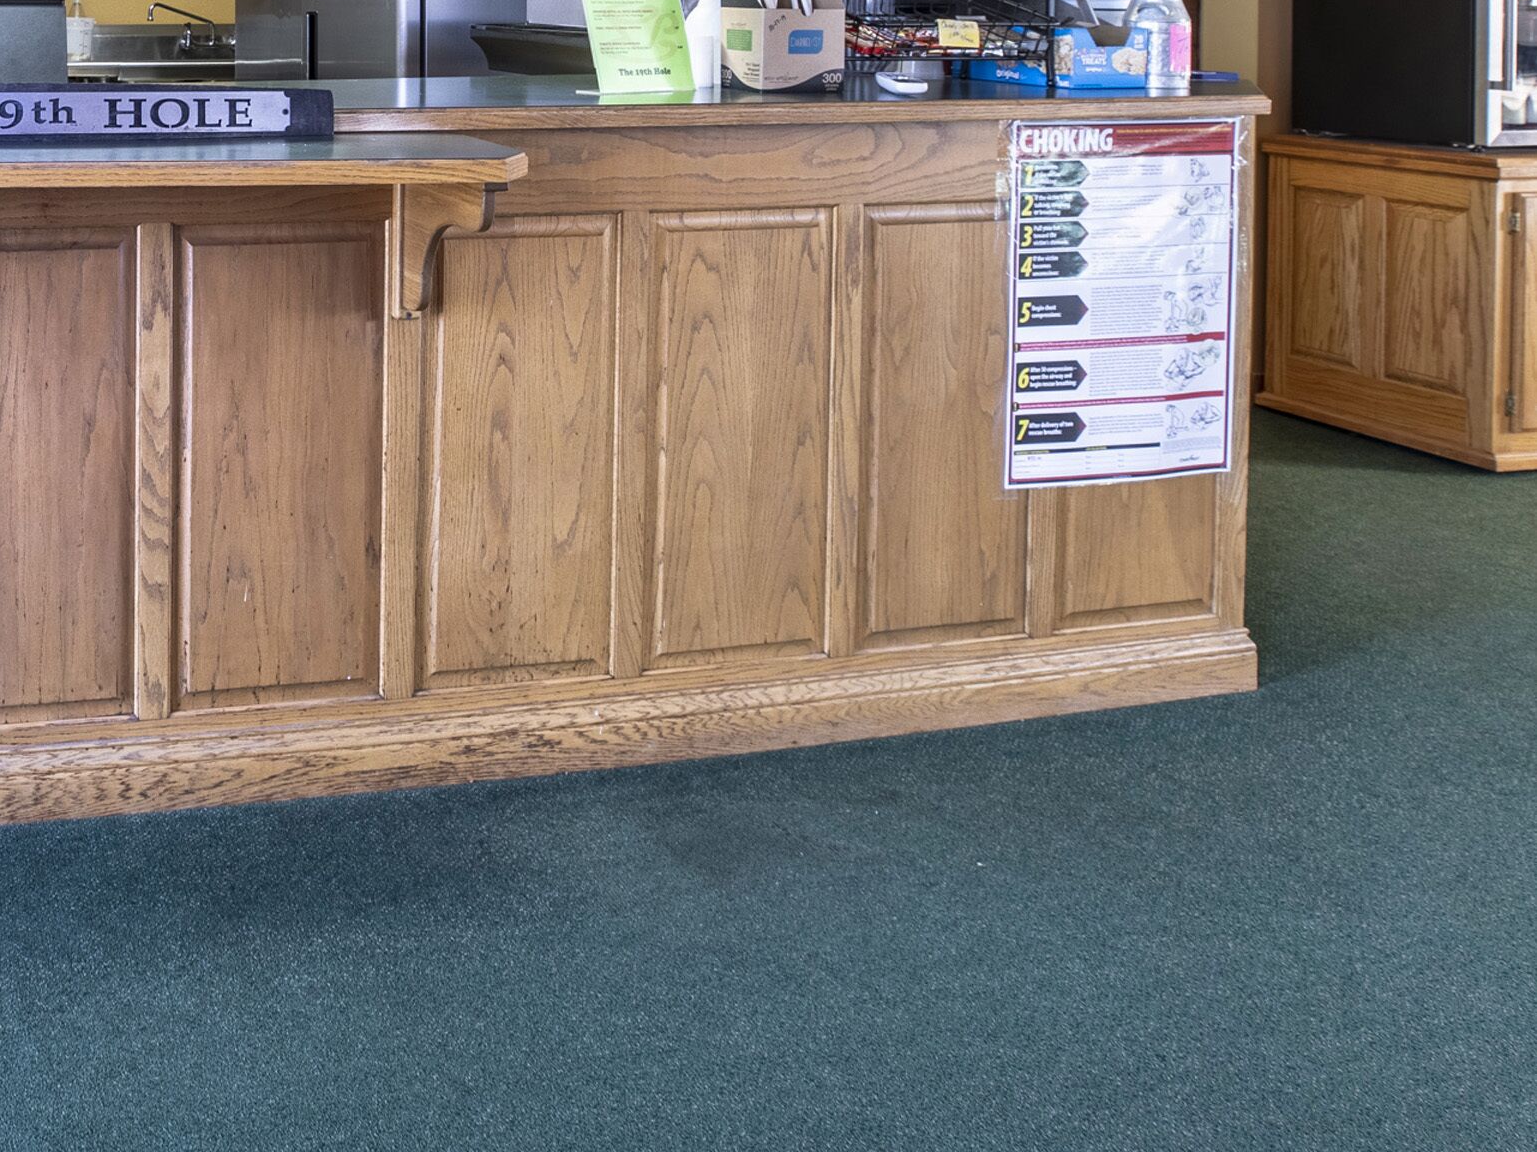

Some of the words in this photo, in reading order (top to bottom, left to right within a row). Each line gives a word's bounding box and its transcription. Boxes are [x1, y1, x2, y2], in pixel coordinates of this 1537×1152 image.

[619, 68, 633, 76] The
[636, 68, 652, 76] 19th
[1082, 58, 1107, 66] TREATS
[823, 73, 842, 83] 300
[103, 98, 253, 130] HOLE
[1020, 128, 1113, 153] CHOKING
[1025, 165, 1033, 185] 1
[1022, 195, 1034, 216] 2
[1021, 226, 1033, 247] 3
[1020, 256, 1033, 277] 4
[1019, 302, 1032, 323] 5
[1018, 368, 1030, 389] 6
[1016, 420, 1029, 441] 7
